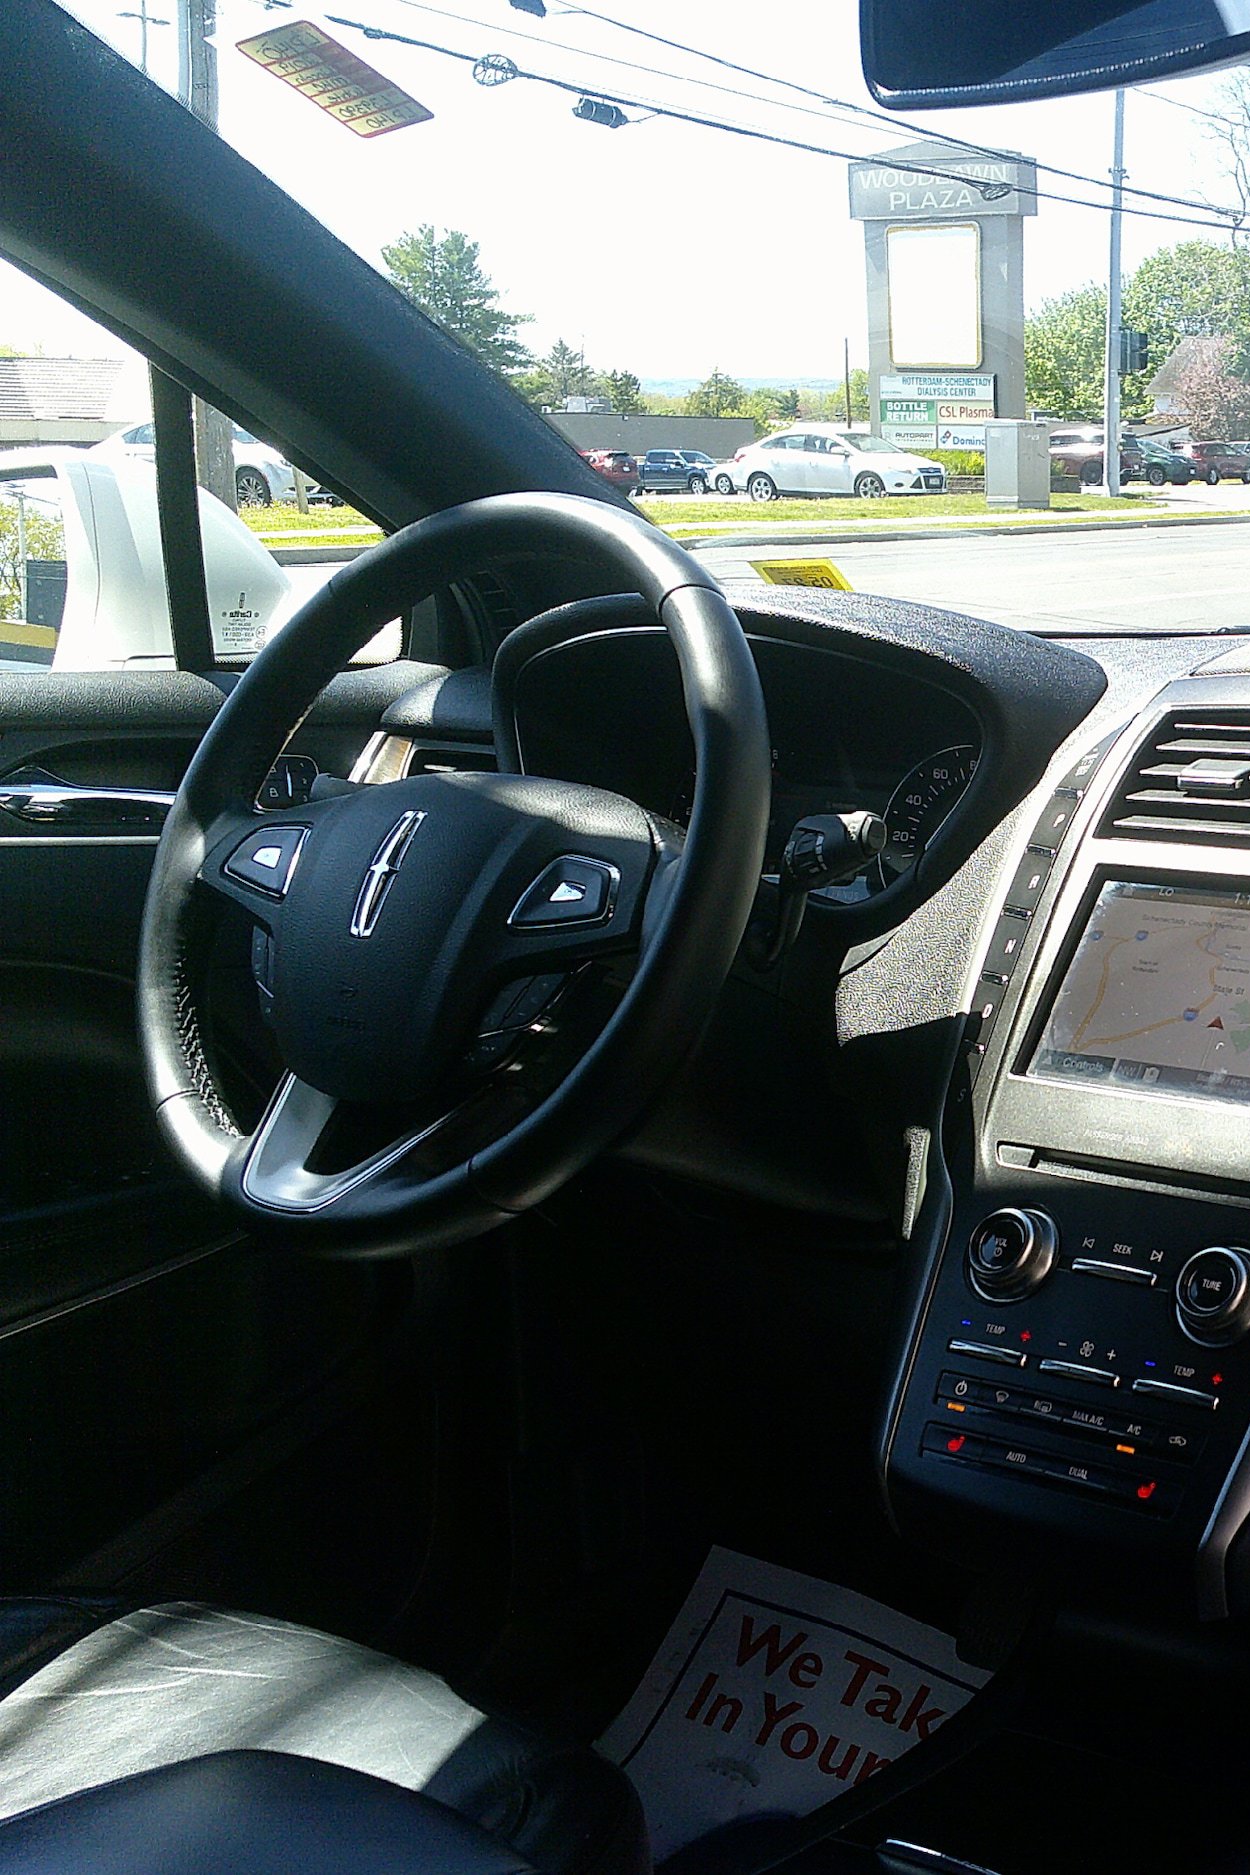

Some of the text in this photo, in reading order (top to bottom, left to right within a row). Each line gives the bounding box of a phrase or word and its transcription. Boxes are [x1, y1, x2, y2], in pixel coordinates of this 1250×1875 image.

[889, 189, 973, 211] PLAZA
[902, 376, 992, 387] ROTTERDAM-SCHENECTADY
[917, 387, 977, 397] DIALYSIS CENTER
[886, 401, 928, 411] BOTTLE
[939, 405, 994, 419] CSL Plasma
[886, 411, 929, 422] RETURN
[932, 768, 949, 780] 60
[905, 794, 922, 805] 40
[892, 830, 909, 842] 20
[1027, 874, 1041, 890] R
[1004, 938, 1017, 954] N
[1112, 1242, 1133, 1256] SEEK
[1201, 1277, 1222, 1292] TUNE
[985, 1323, 1006, 1335] TEMP
[1173, 1364, 1196, 1378] TEMP
[1072, 1410, 1105, 1426] MAX A/C
[1127, 1423, 1142, 1436] A/C
[1005, 1450, 1027, 1463] AUTO
[1068, 1466, 1088, 1480] DUAL
[735, 1615, 824, 1689] We
[685, 1672, 744, 1734] In
